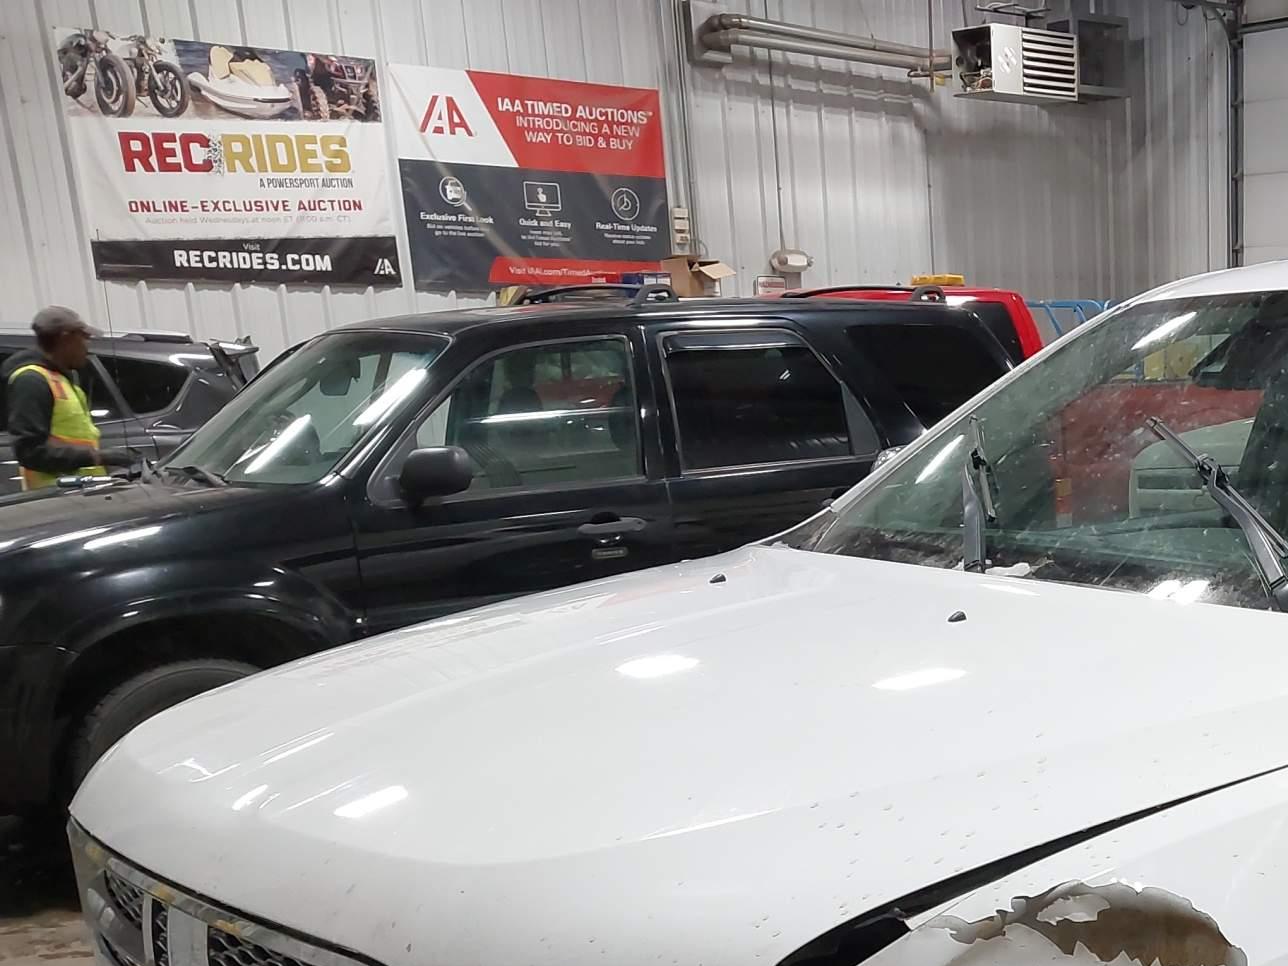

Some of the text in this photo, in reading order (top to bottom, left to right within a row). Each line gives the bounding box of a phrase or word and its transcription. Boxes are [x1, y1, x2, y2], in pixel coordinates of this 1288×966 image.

[497, 97, 524, 113] IAA
[524, 100, 572, 118] TIMED
[516, 116, 640, 138] INTRODUCING A NEW
[524, 130, 633, 151] WAY TO BID & BUY
[118, 131, 353, 174] REC RIDES
[259, 178, 354, 189] A POWERSPORT AUCTION
[128, 200, 363, 214] ONLINE-EXCLUSIVE AUCTION
[145, 217, 177, 225] Auction
[420, 211, 494, 224] Exclusive First Look
[518, 217, 538, 227] Quick
[554, 219, 572, 229] Easy
[595, 222, 658, 232] Real-Time Updates
[242, 243, 261, 251] Visit
[173, 250, 332, 272] RECRIDES.COM
[508, 265, 526, 275] Visit
